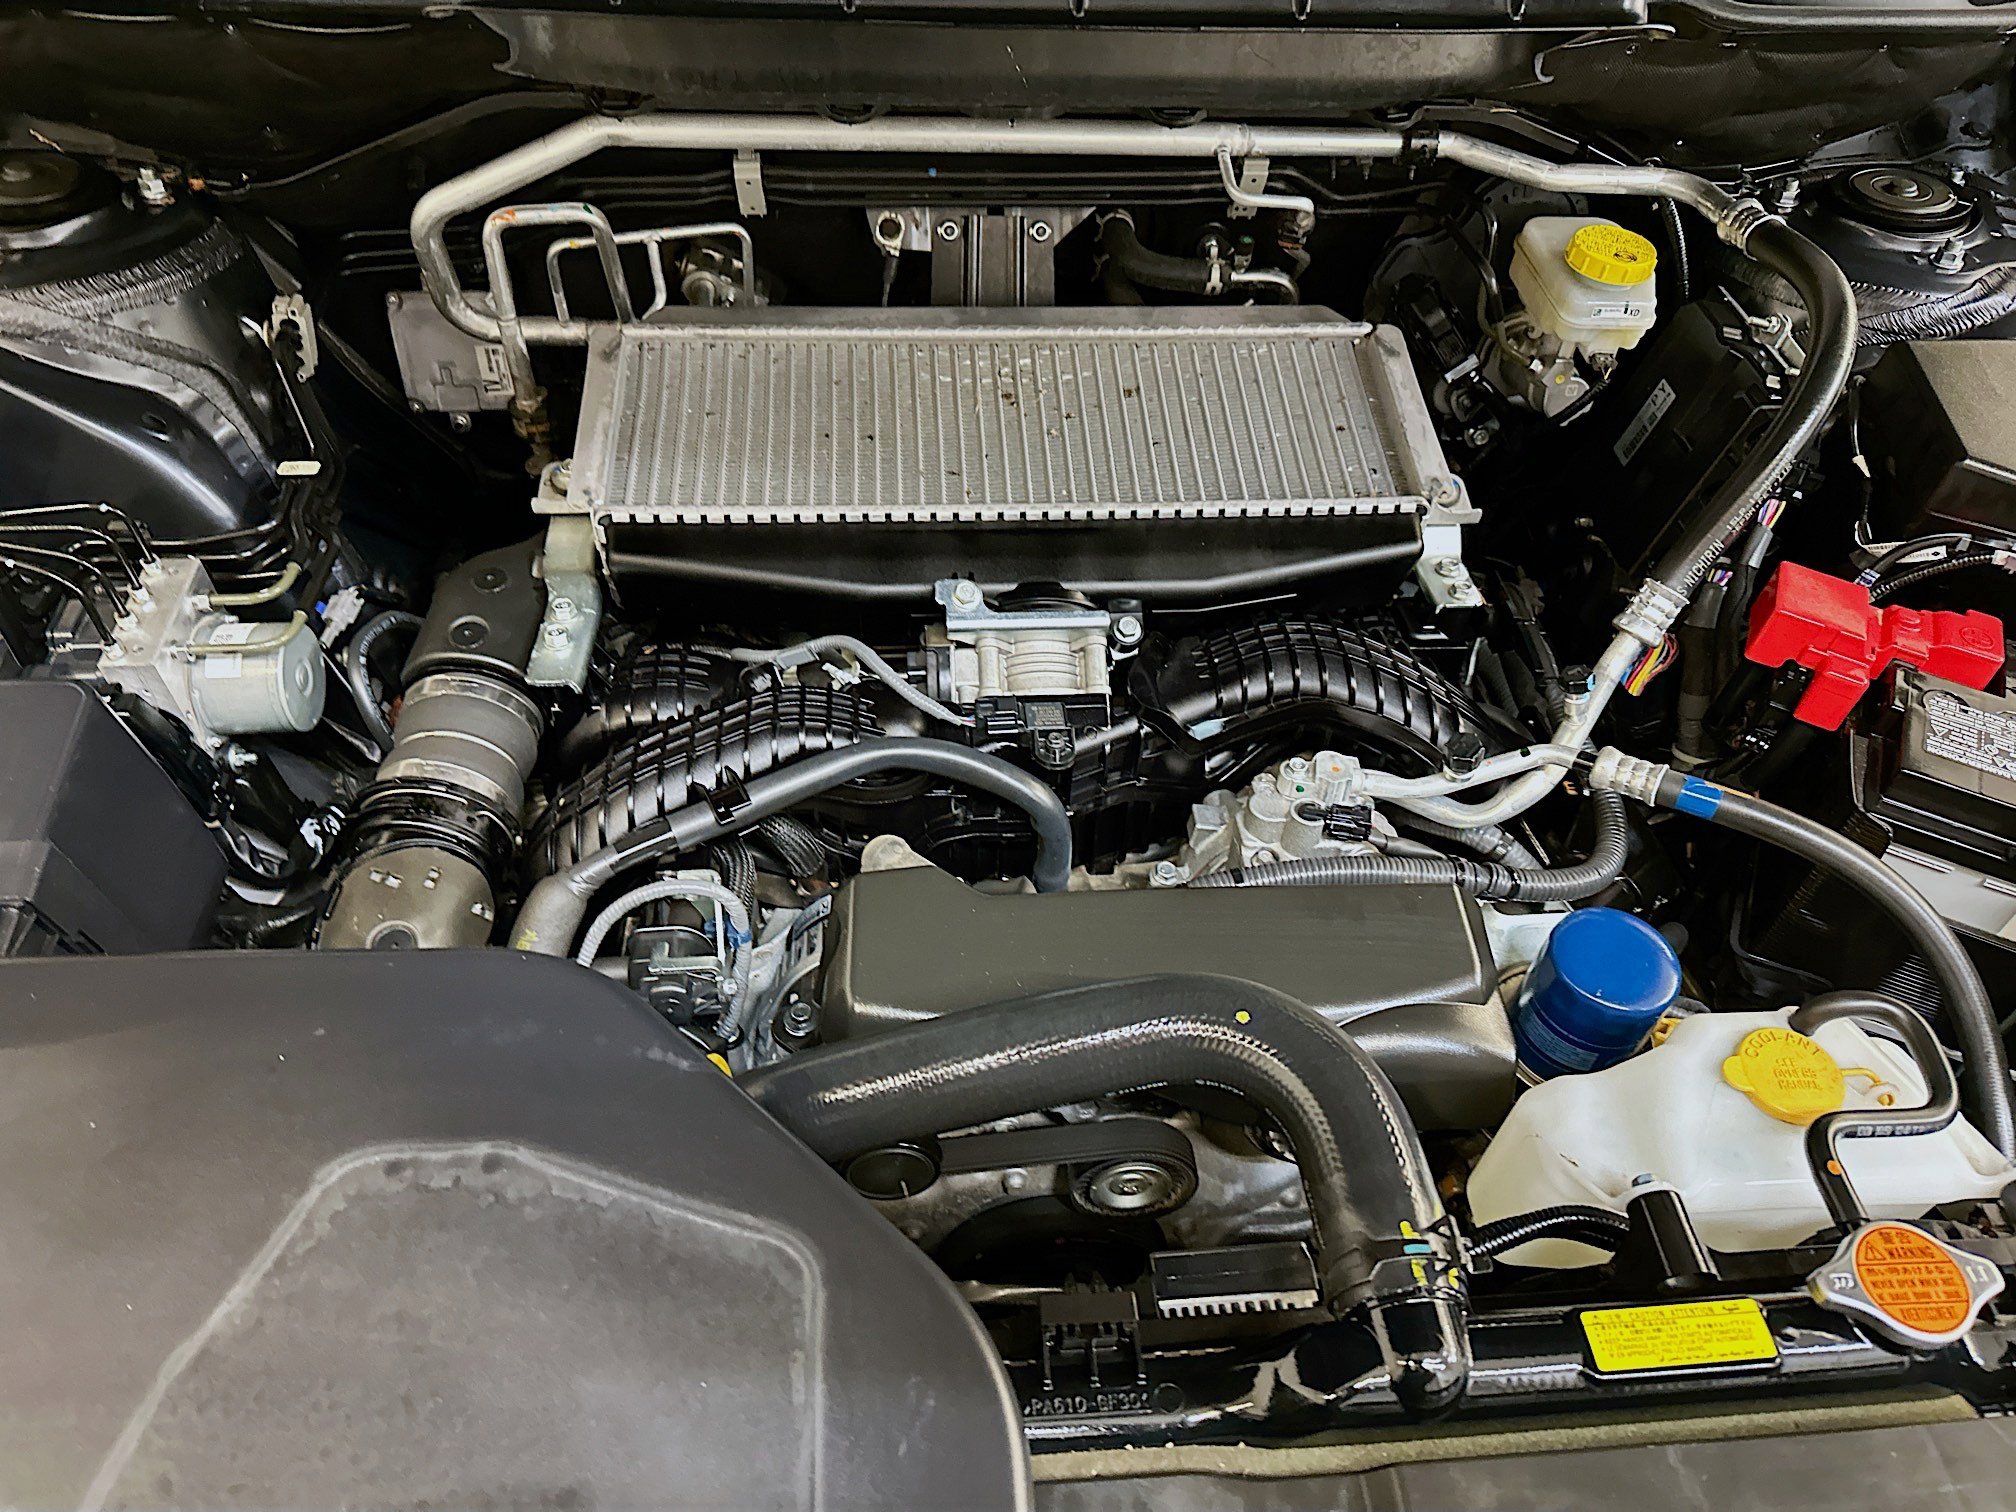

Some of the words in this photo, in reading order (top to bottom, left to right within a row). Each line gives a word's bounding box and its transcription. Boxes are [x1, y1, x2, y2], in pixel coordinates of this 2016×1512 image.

[1744, 1030, 1824, 1058] COOLANT
[1884, 1246, 1935, 1260] WARNING
[1628, 1310, 1664, 1321] CAUTION
[1670, 1306, 1715, 1318] ATTENTION
